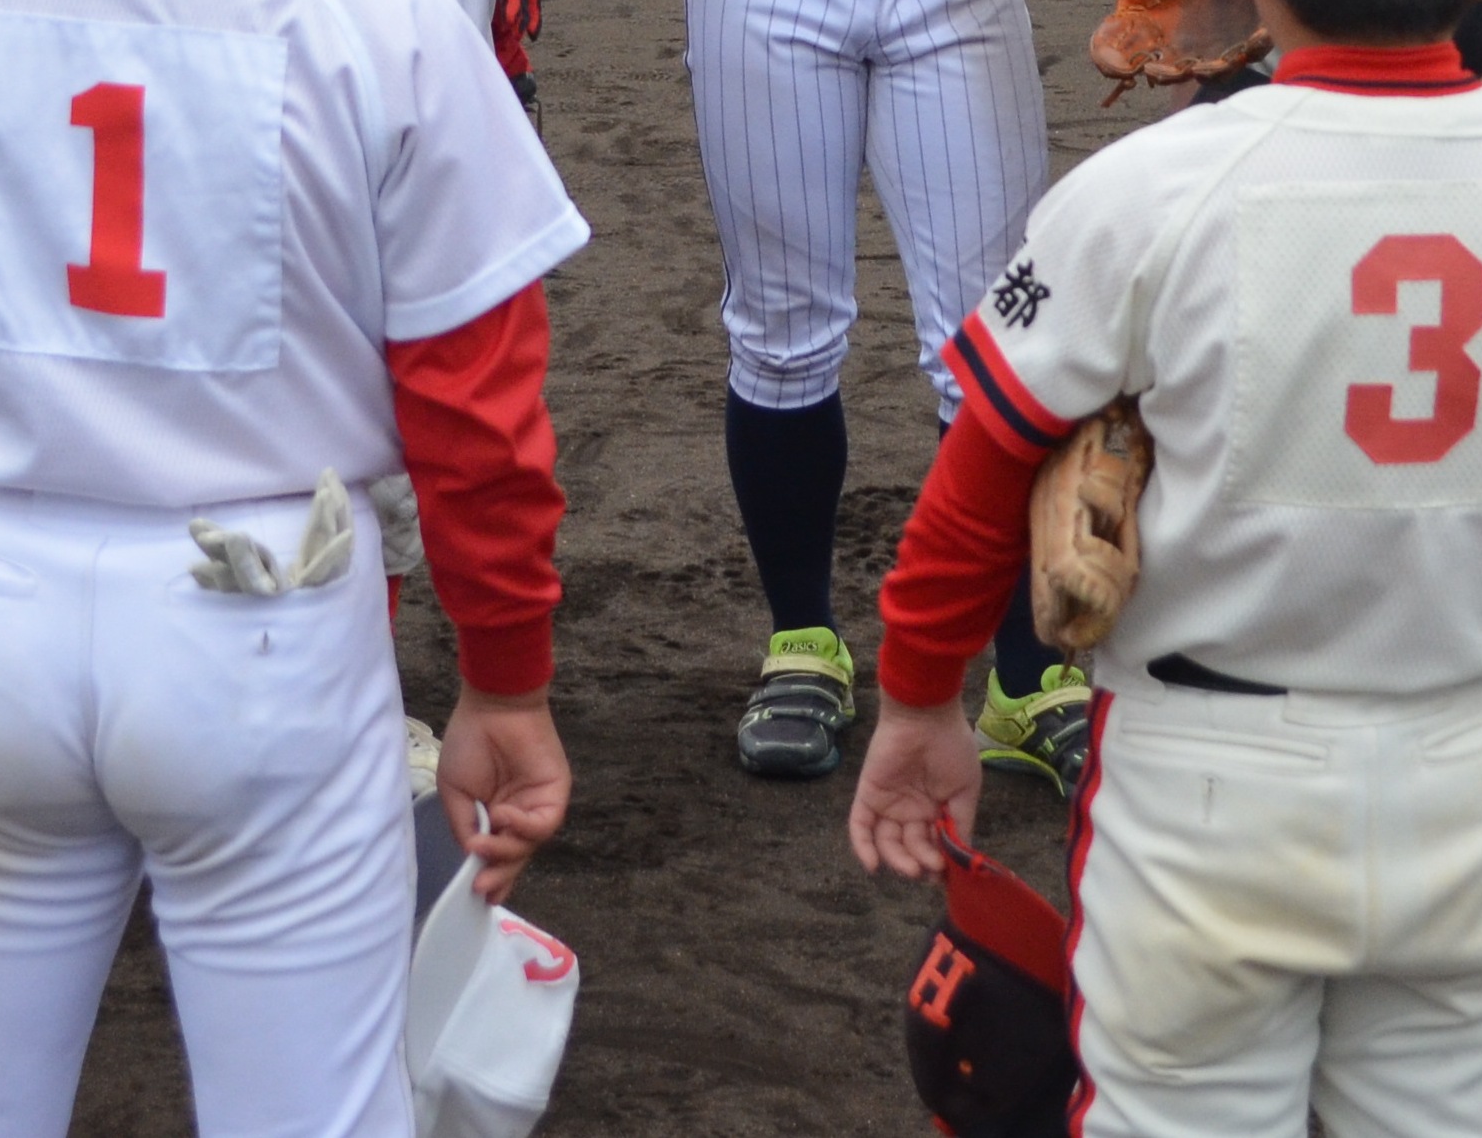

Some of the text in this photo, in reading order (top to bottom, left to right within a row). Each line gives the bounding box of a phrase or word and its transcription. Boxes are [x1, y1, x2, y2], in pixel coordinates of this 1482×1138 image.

[67, 81, 167, 319] 1
[992, 258, 1050, 328] 都
[909, 932, 975, 1029] H
